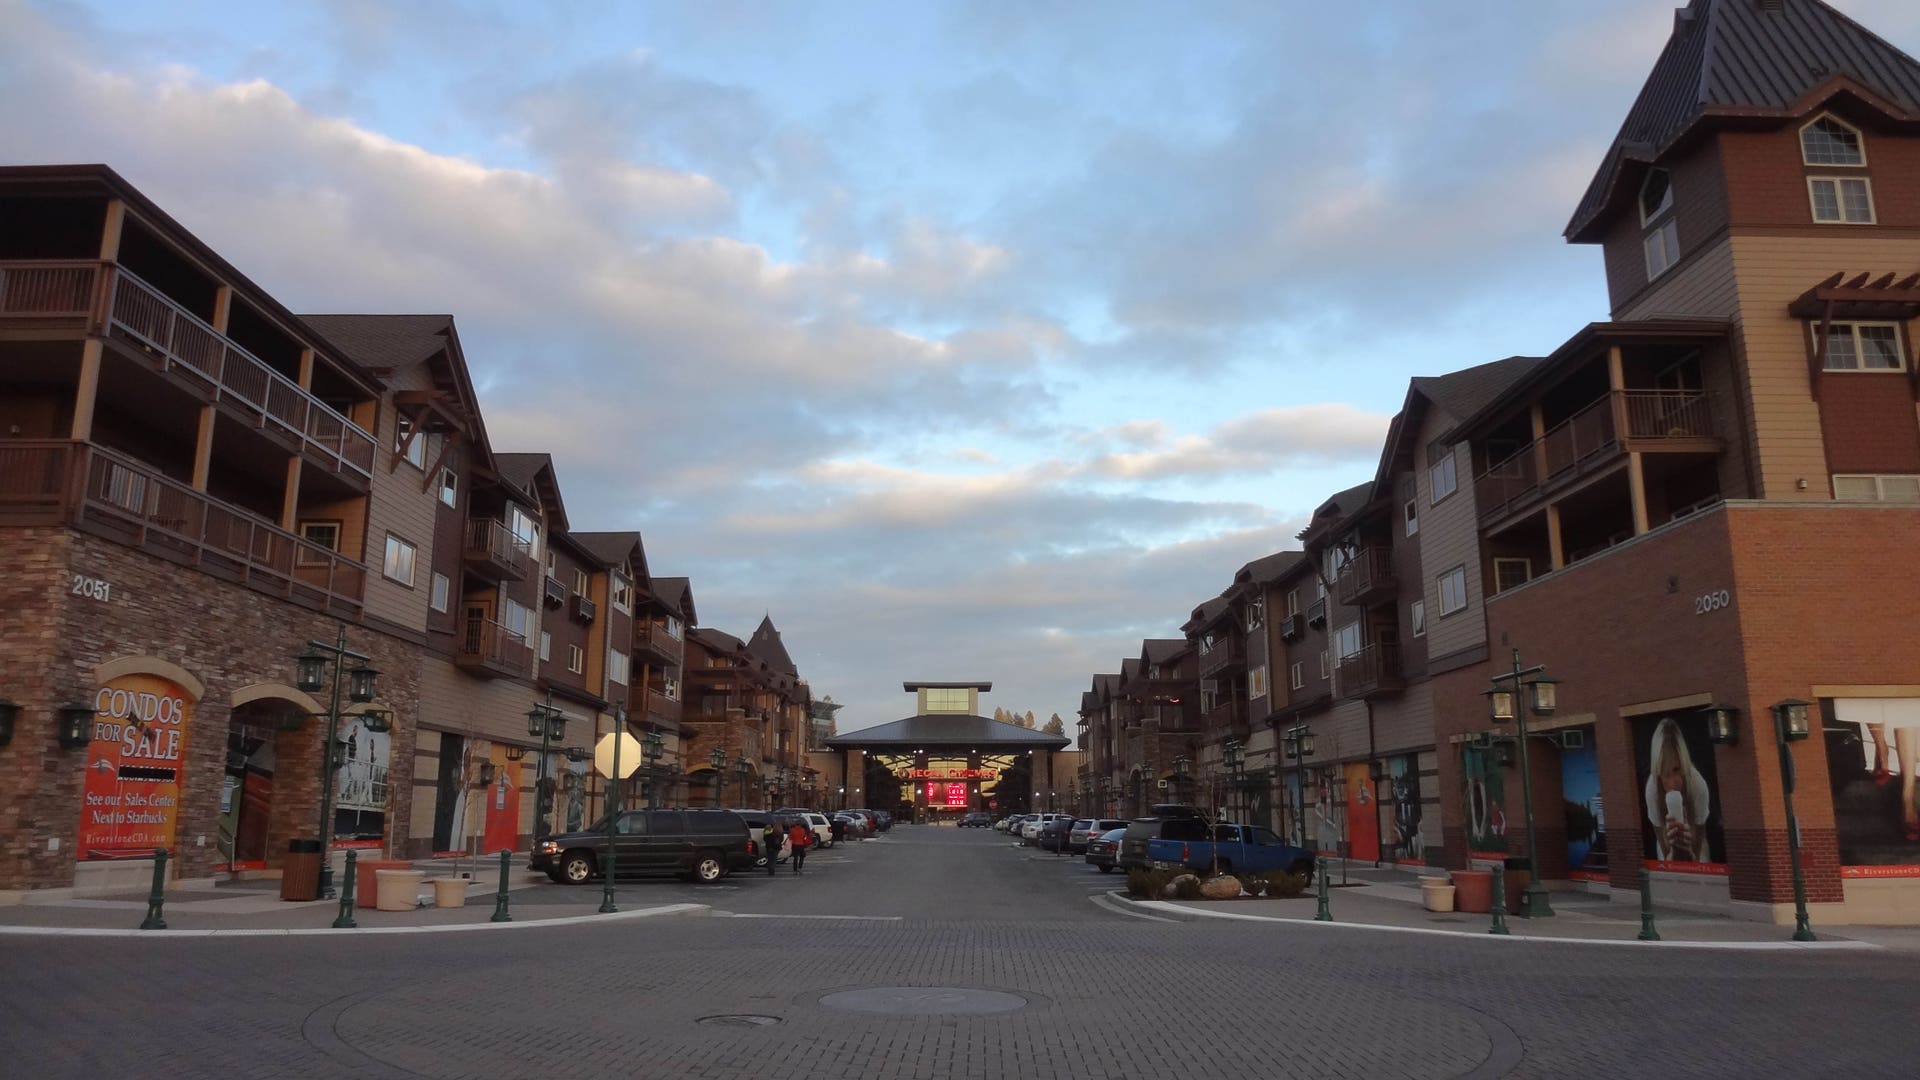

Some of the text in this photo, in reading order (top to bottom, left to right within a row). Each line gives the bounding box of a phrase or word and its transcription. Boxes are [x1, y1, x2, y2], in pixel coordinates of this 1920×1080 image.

[72, 575, 110, 602] 2051
[1695, 590, 1729, 615] 2050
[95, 687, 183, 724] CONDOS
[95, 722, 180, 760] FOR SALE
[86, 792, 176, 807] See our Sales Center
[92, 810, 167, 824] Next to Starbucks
